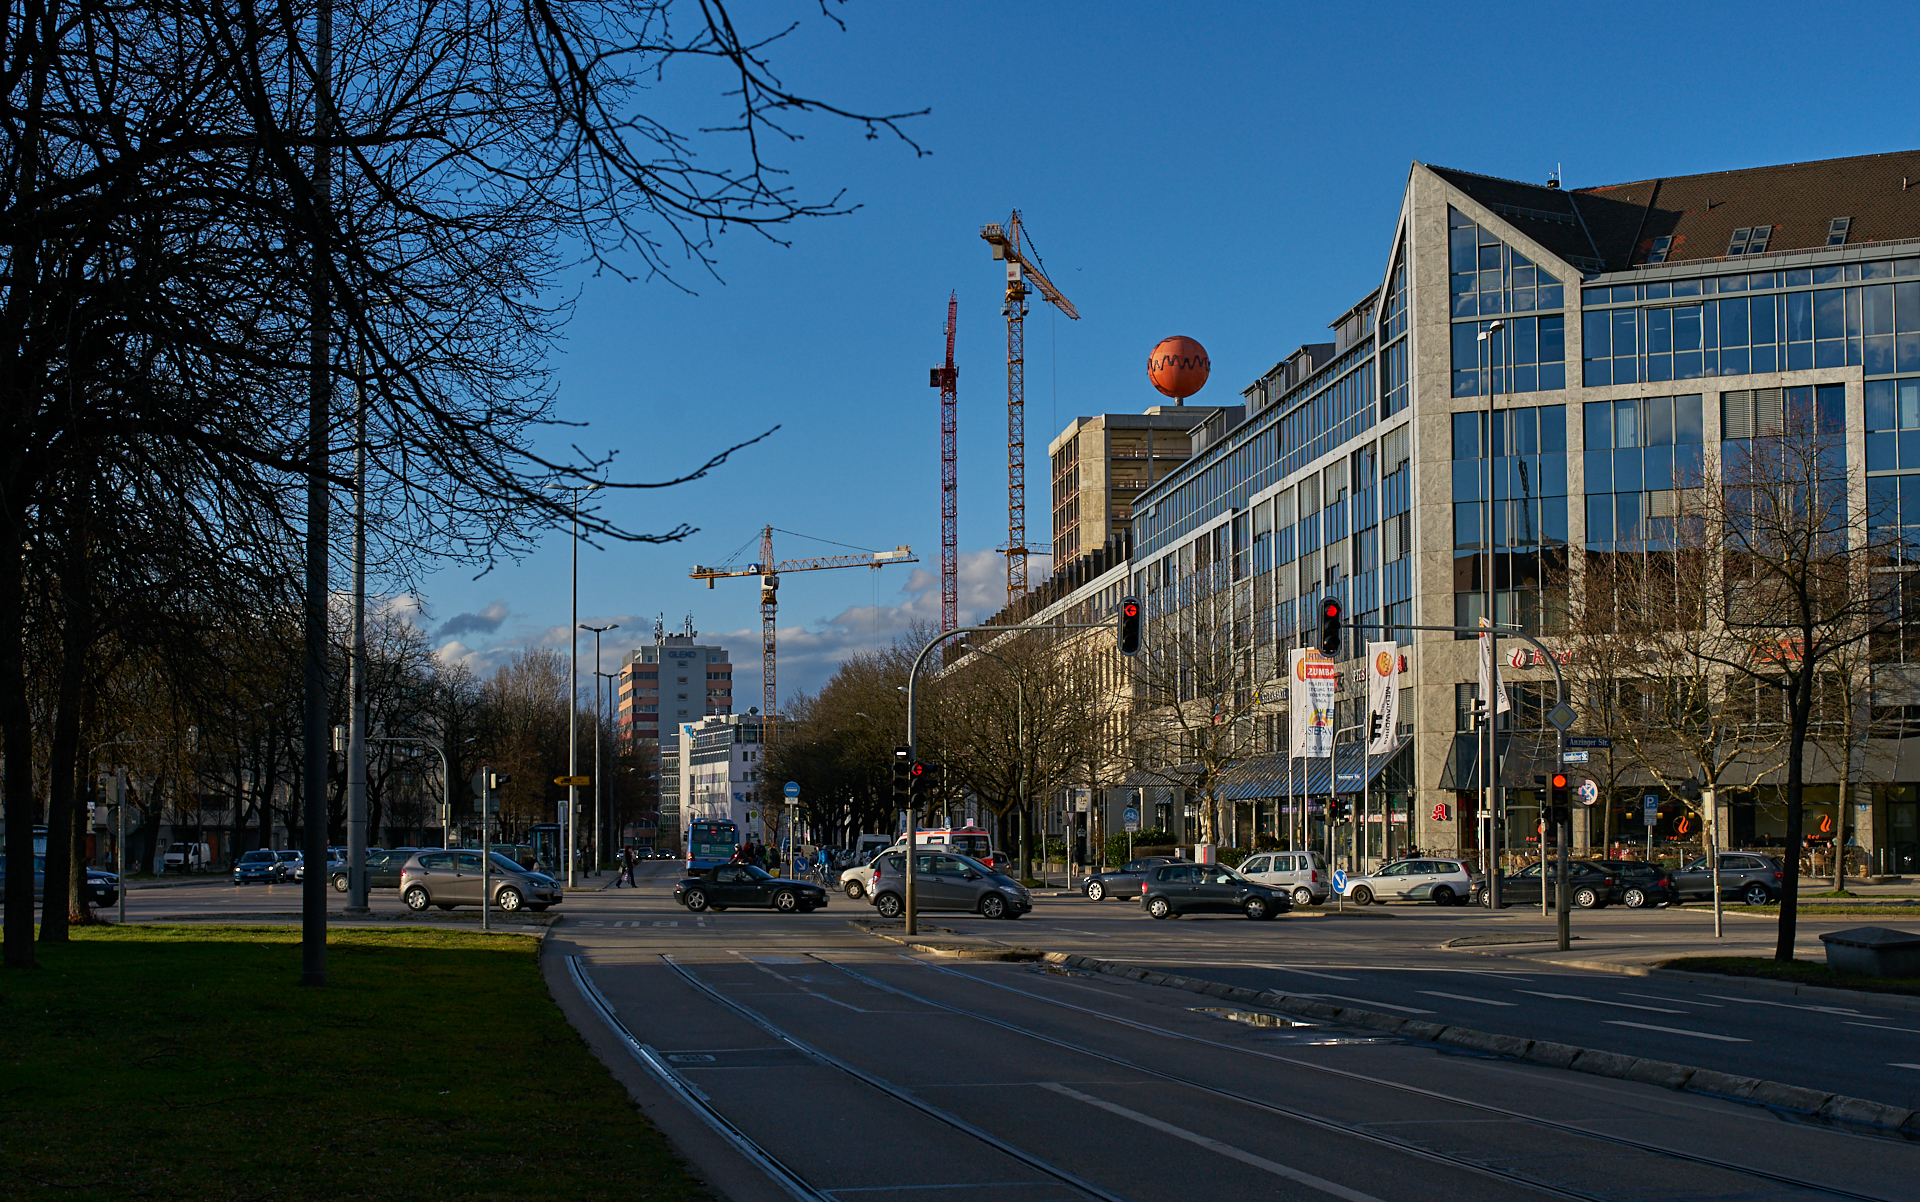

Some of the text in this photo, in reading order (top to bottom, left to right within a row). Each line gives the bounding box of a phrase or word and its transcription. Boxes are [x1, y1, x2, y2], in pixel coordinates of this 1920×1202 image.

[1308, 652, 1333, 661] FITN
[1307, 667, 1334, 676] ZUMBA
[1569, 738, 1609, 747] Anzinger Str.
[576, 920, 680, 928] BUS
